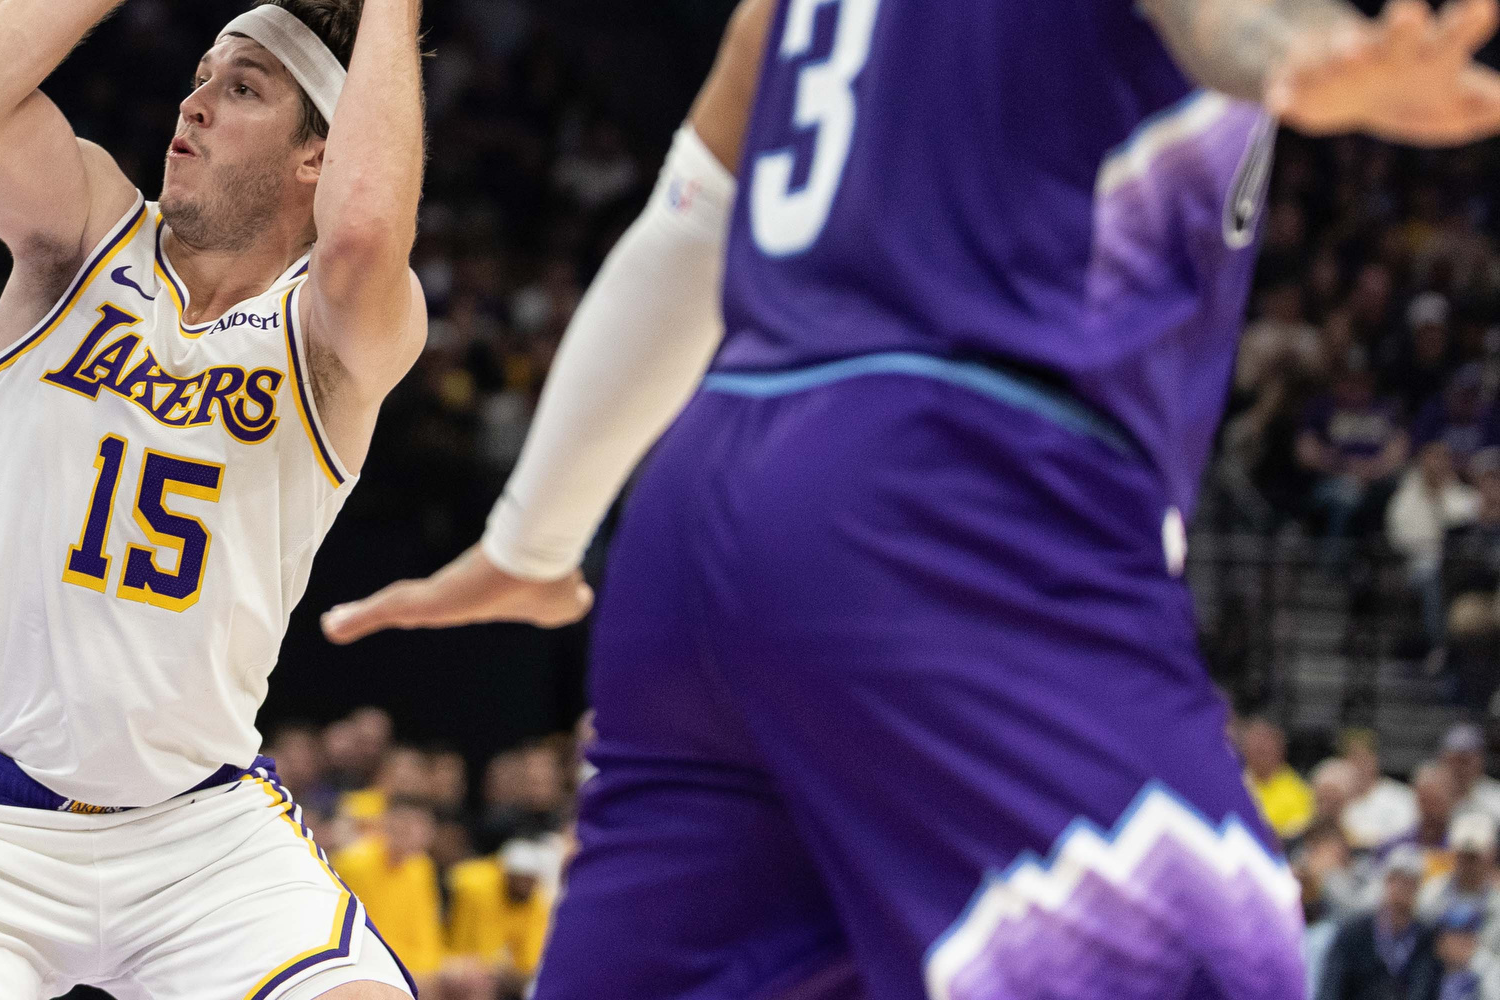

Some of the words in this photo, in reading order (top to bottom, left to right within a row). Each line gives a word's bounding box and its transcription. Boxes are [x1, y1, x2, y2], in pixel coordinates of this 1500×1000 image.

[40, 300, 286, 445] LAKERS
[209, 311, 280, 335] Albert
[61, 431, 226, 613] 15
